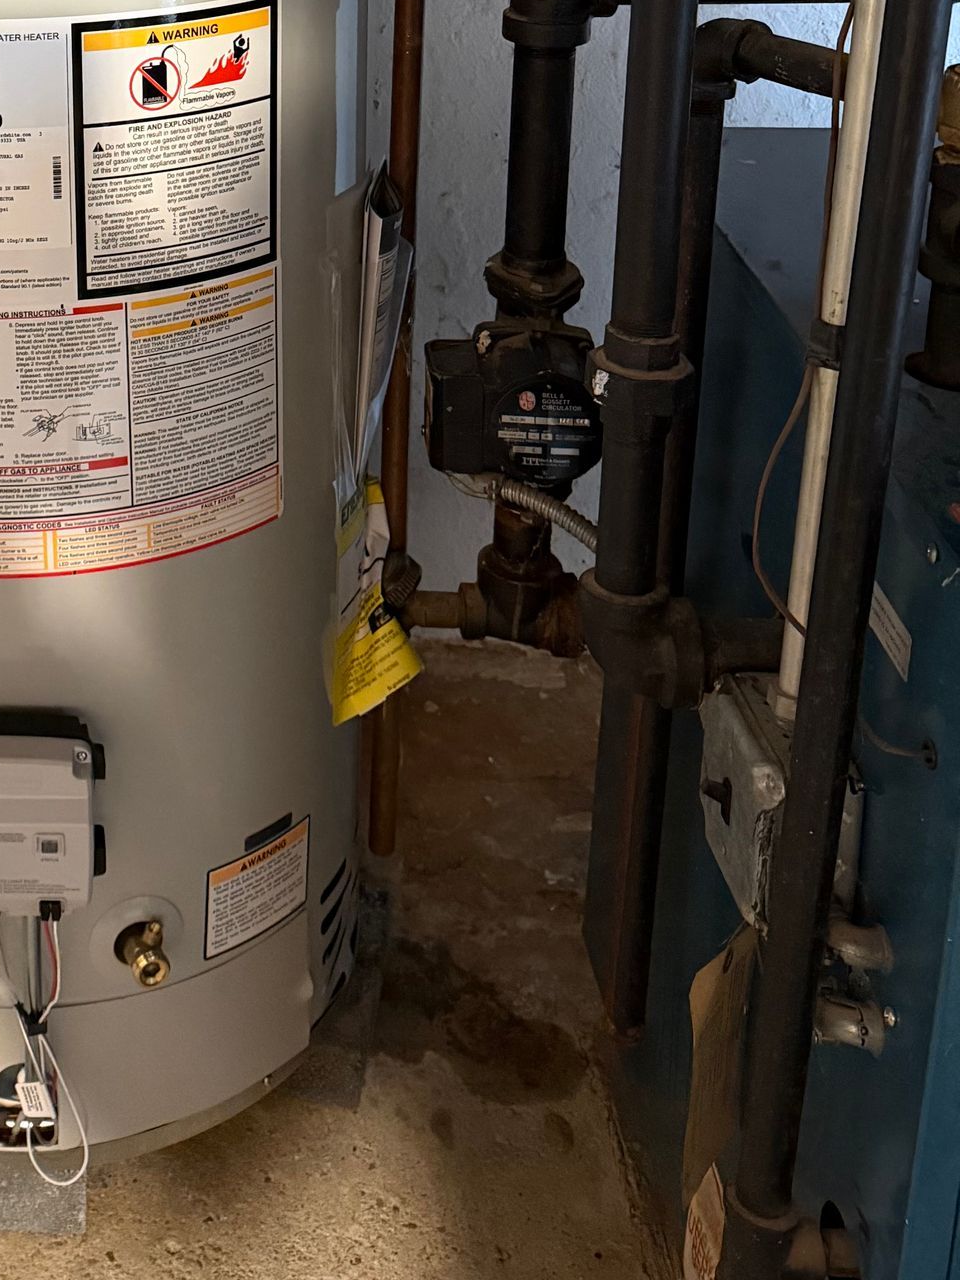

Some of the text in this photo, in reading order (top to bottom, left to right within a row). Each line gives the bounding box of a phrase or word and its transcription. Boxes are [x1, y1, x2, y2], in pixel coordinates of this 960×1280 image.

[23, 32, 59, 41] HEATER
[163, 24, 219, 41] WARNING
[183, 90, 235, 104] Flammable Vapors
[164, 116, 204, 128] EXPLOSION
[206, 111, 231, 121] HAZARD
[163, 134, 185, 144] gasoline
[209, 126, 235, 135] flammable
[236, 122, 251, 130] vapors
[93, 151, 112, 160] liquids
[132, 147, 151, 155] vicinity
[205, 134, 229, 143] appliance.
[233, 129, 251, 138] Storage
[113, 157, 138, 166] gasoline
[163, 148, 191, 158] flammable
[219, 140, 234, 148] liquids
[250, 133, 264, 141] vicinity
[199, 283, 229, 296] WARNING
[198, 296, 211, 305] YOUR
[212, 293, 229, 301] SAFETY
[11, 309, 66, 318] INSTRUCTIONS
[199, 311, 229, 324] WARNING
[200, 406, 227, 417] CALIFORNIA
[228, 400, 243, 409] NOTICE
[40, 464, 80, 474] APPLIANCE
[201, 495, 236, 510] FAULT STATUS
[36, 521, 62, 529] CODES
[85, 523, 120, 534] LED STATUS
[247, 839, 287, 867] WARNING
